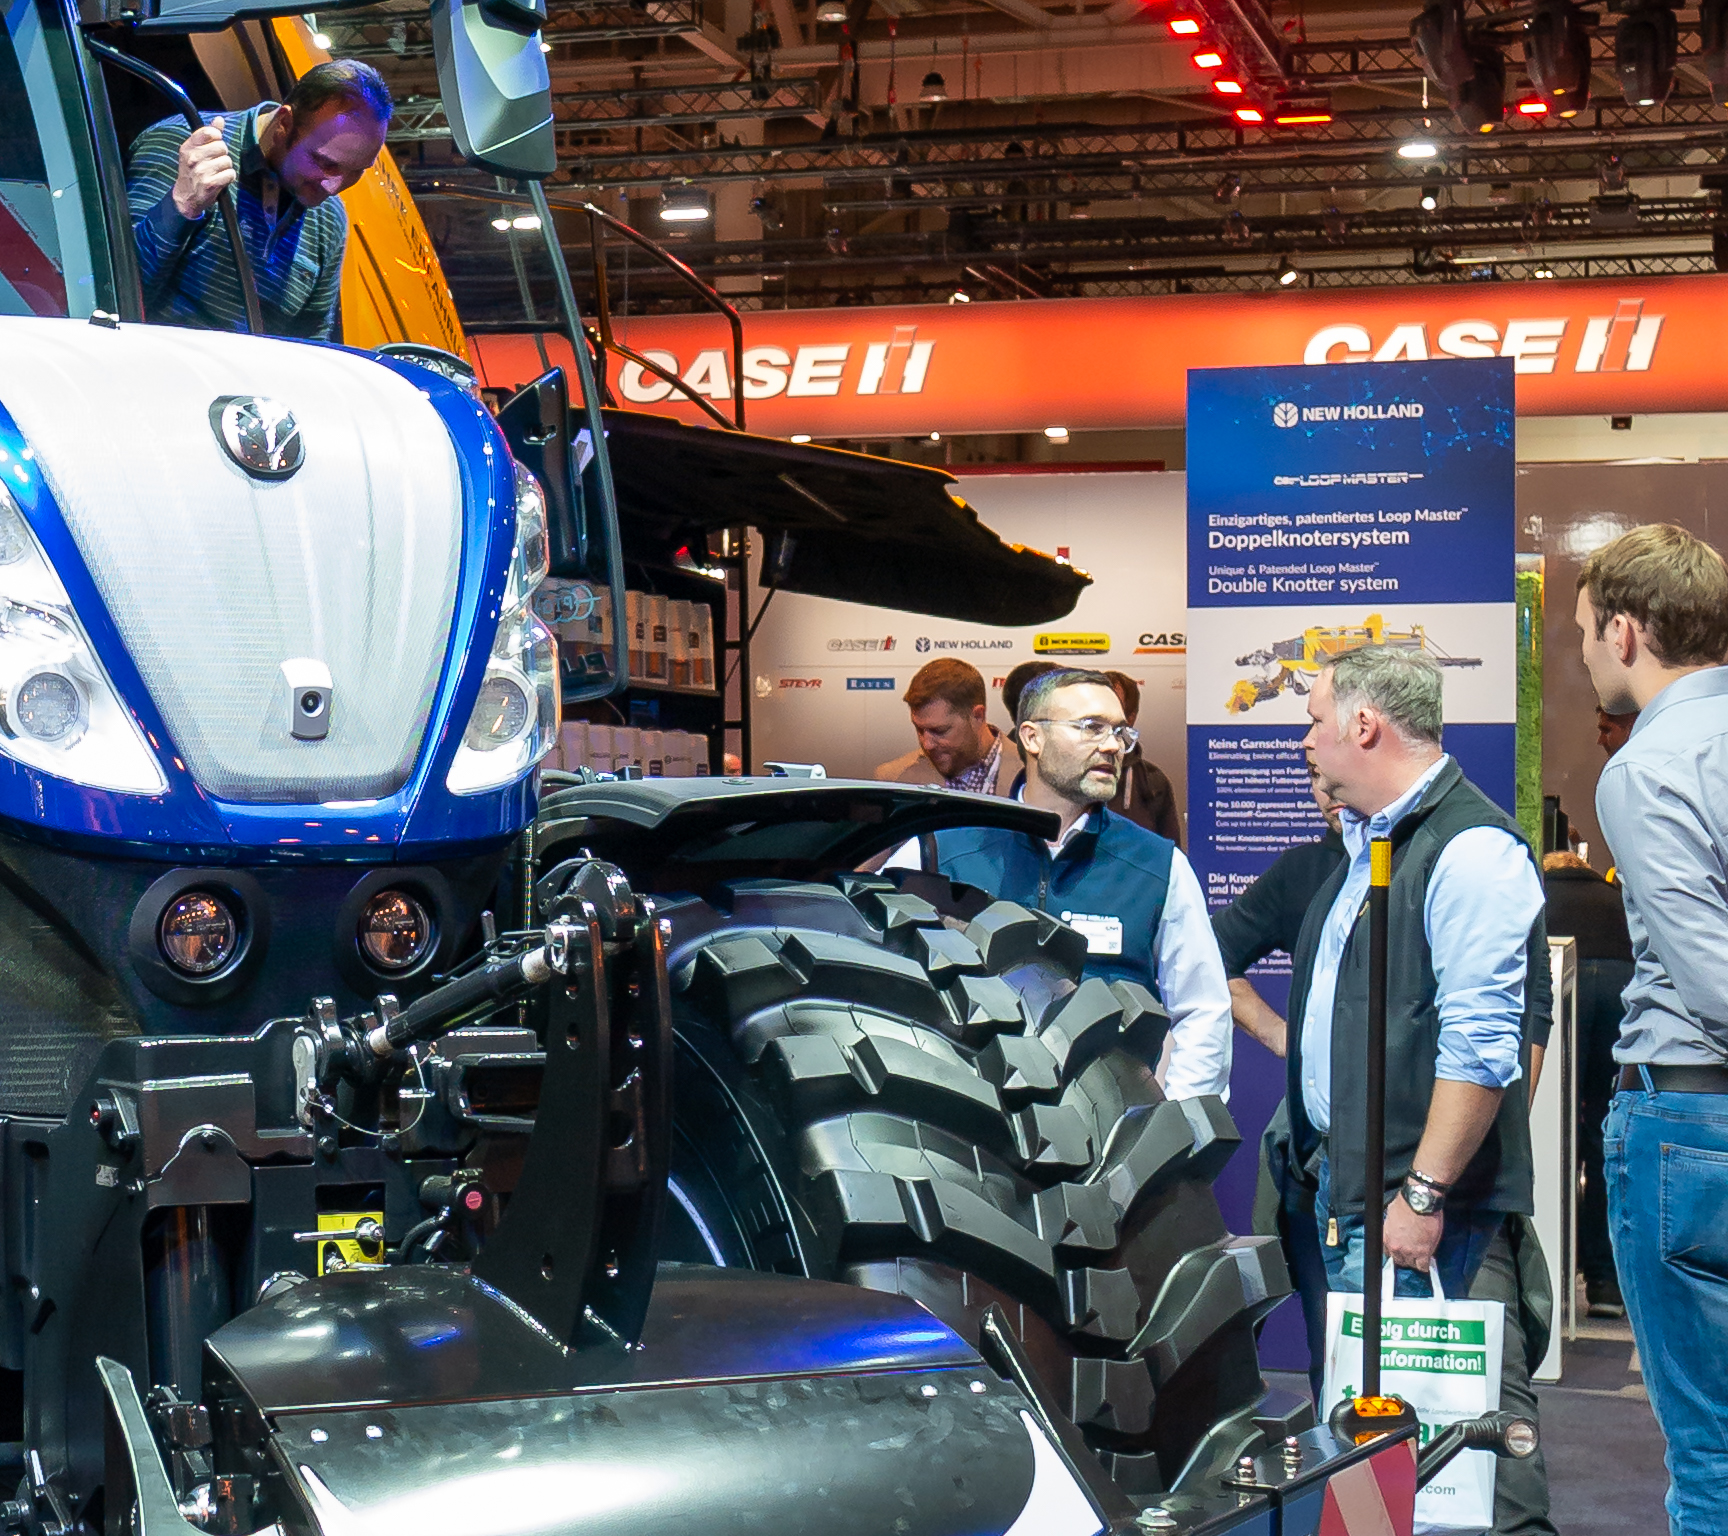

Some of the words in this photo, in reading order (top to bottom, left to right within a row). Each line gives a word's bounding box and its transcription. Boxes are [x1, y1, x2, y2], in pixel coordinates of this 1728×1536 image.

[1303, 317, 1570, 375] CASE
[618, 342, 853, 404] CASE
[1302, 406, 1339, 422] NEW
[1343, 403, 1424, 420] HOLLAND
[1208, 513, 1292, 528] Einzigartiges,
[1295, 511, 1375, 527] patentiertes
[1378, 509, 1412, 524] Loop
[1208, 528, 1411, 552] Doppelknotersystem
[1208, 564, 1245, 577] Unique
[1309, 562, 1336, 576] Loop
[1208, 576, 1268, 594] Double
[1272, 574, 1336, 593] Knotter
[1340, 577, 1399, 594] system
[934, 640, 959, 649] NEW
[961, 639, 1013, 649] HOLLAND
[1138, 632, 1187, 646] CAS
[1208, 738, 1238, 750] Keine
[1208, 872, 1227, 884] Die
[1208, 884, 1229, 895] und
[1407, 1320, 1461, 1340] durch
[1379, 1347, 1482, 1371] nformation!
